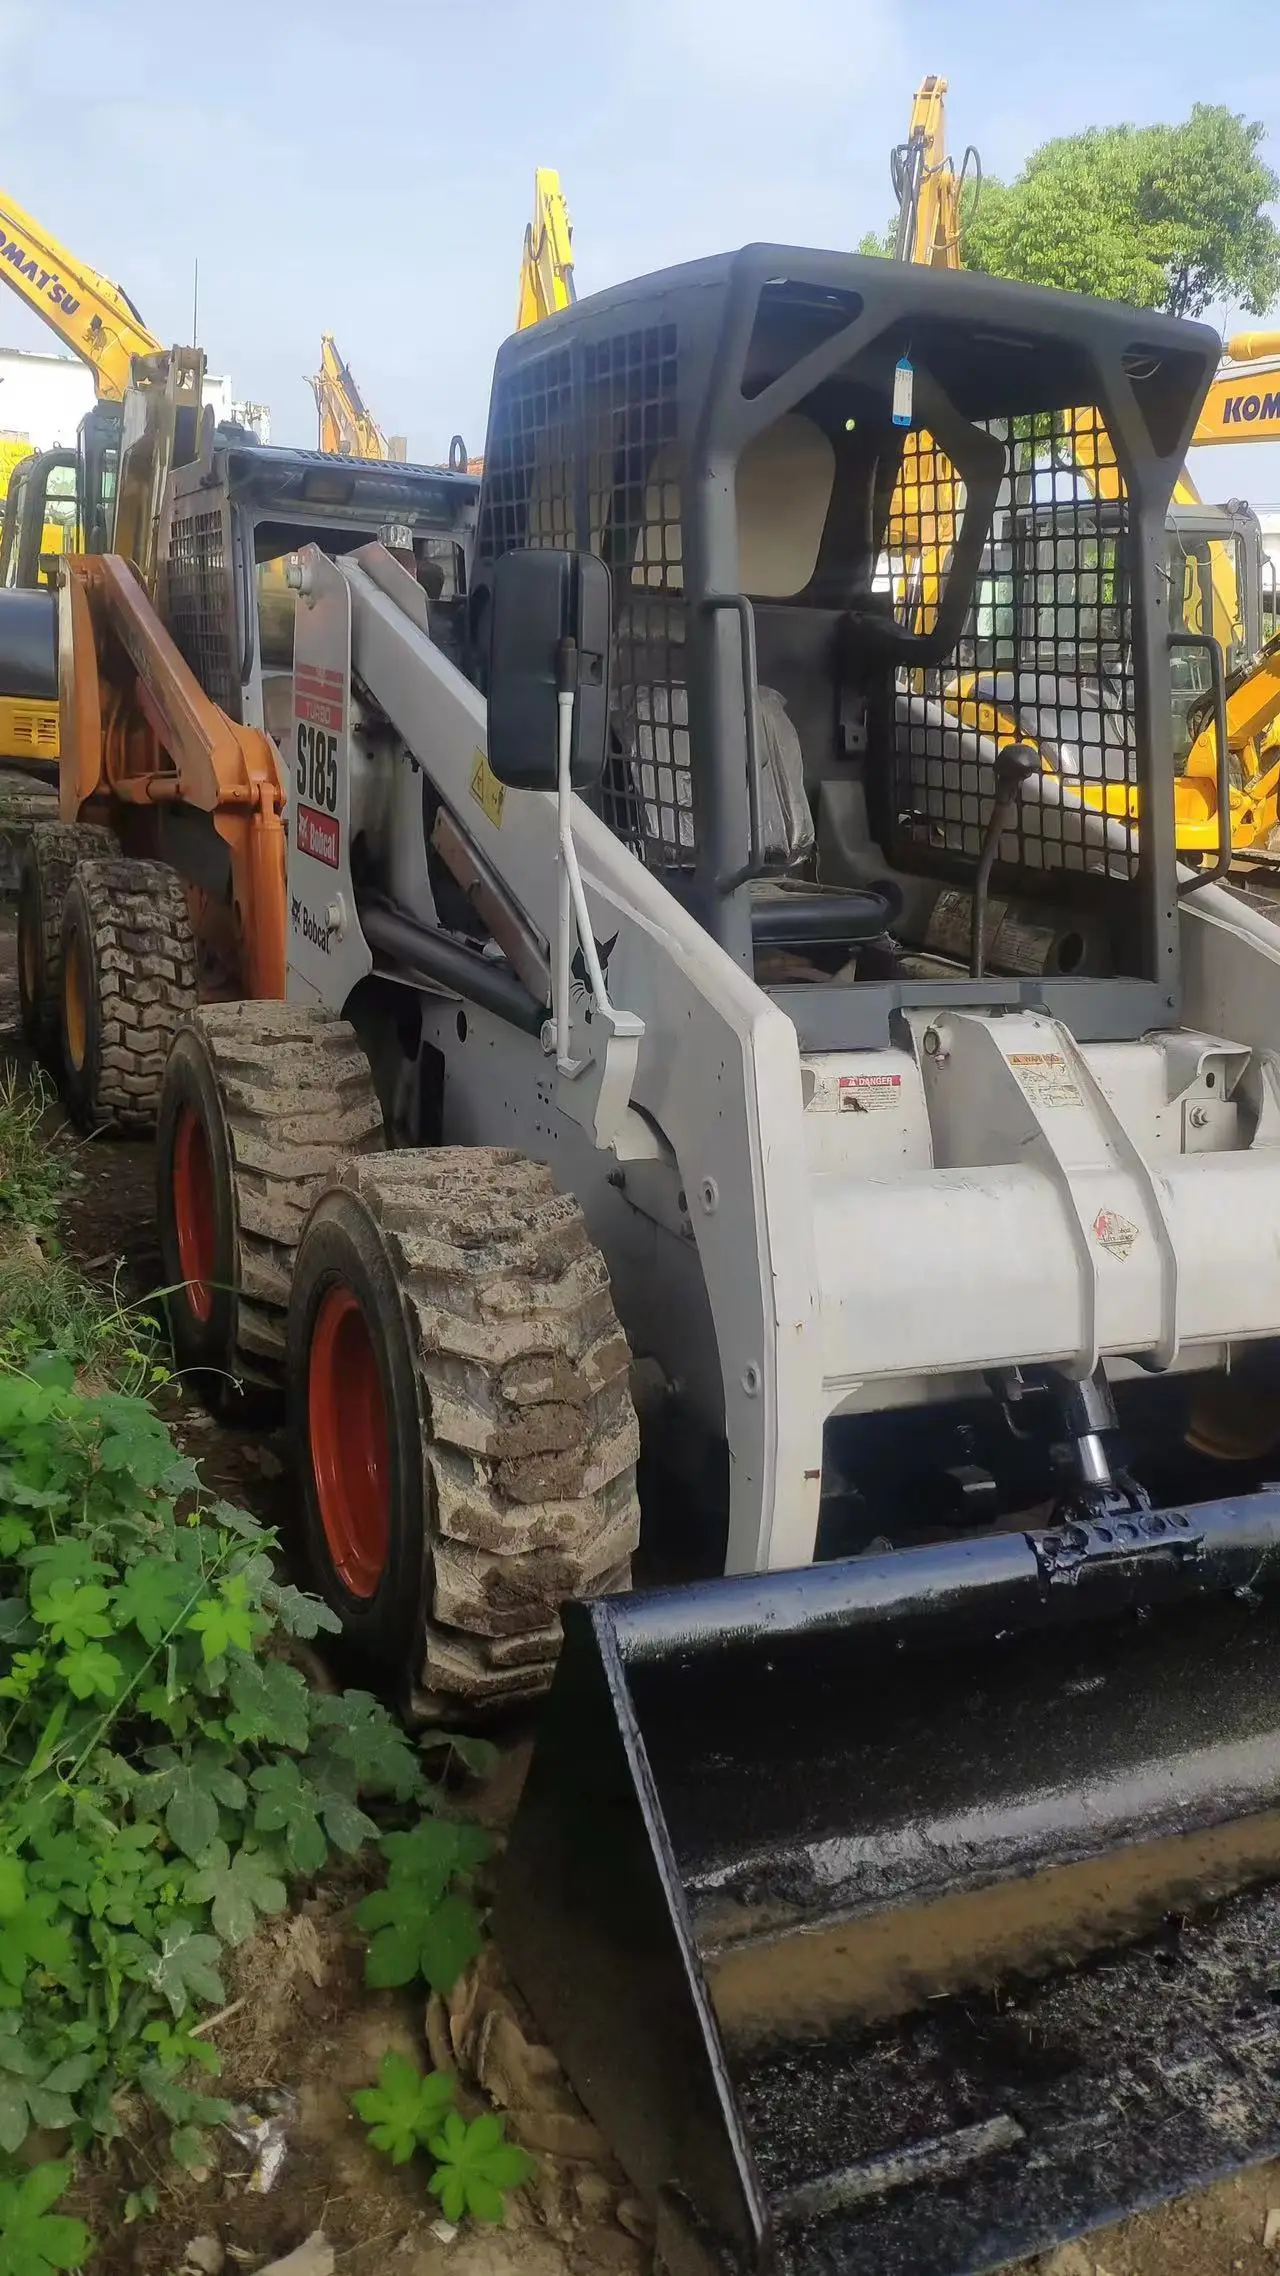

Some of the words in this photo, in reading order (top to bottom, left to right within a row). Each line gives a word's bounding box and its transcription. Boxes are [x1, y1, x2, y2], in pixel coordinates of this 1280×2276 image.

[297, 723, 337, 812] S185
[310, 823, 336, 861] Bobcat
[303, 907, 331, 955] Bobcat
[859, 1077, 892, 1086] DANGER
